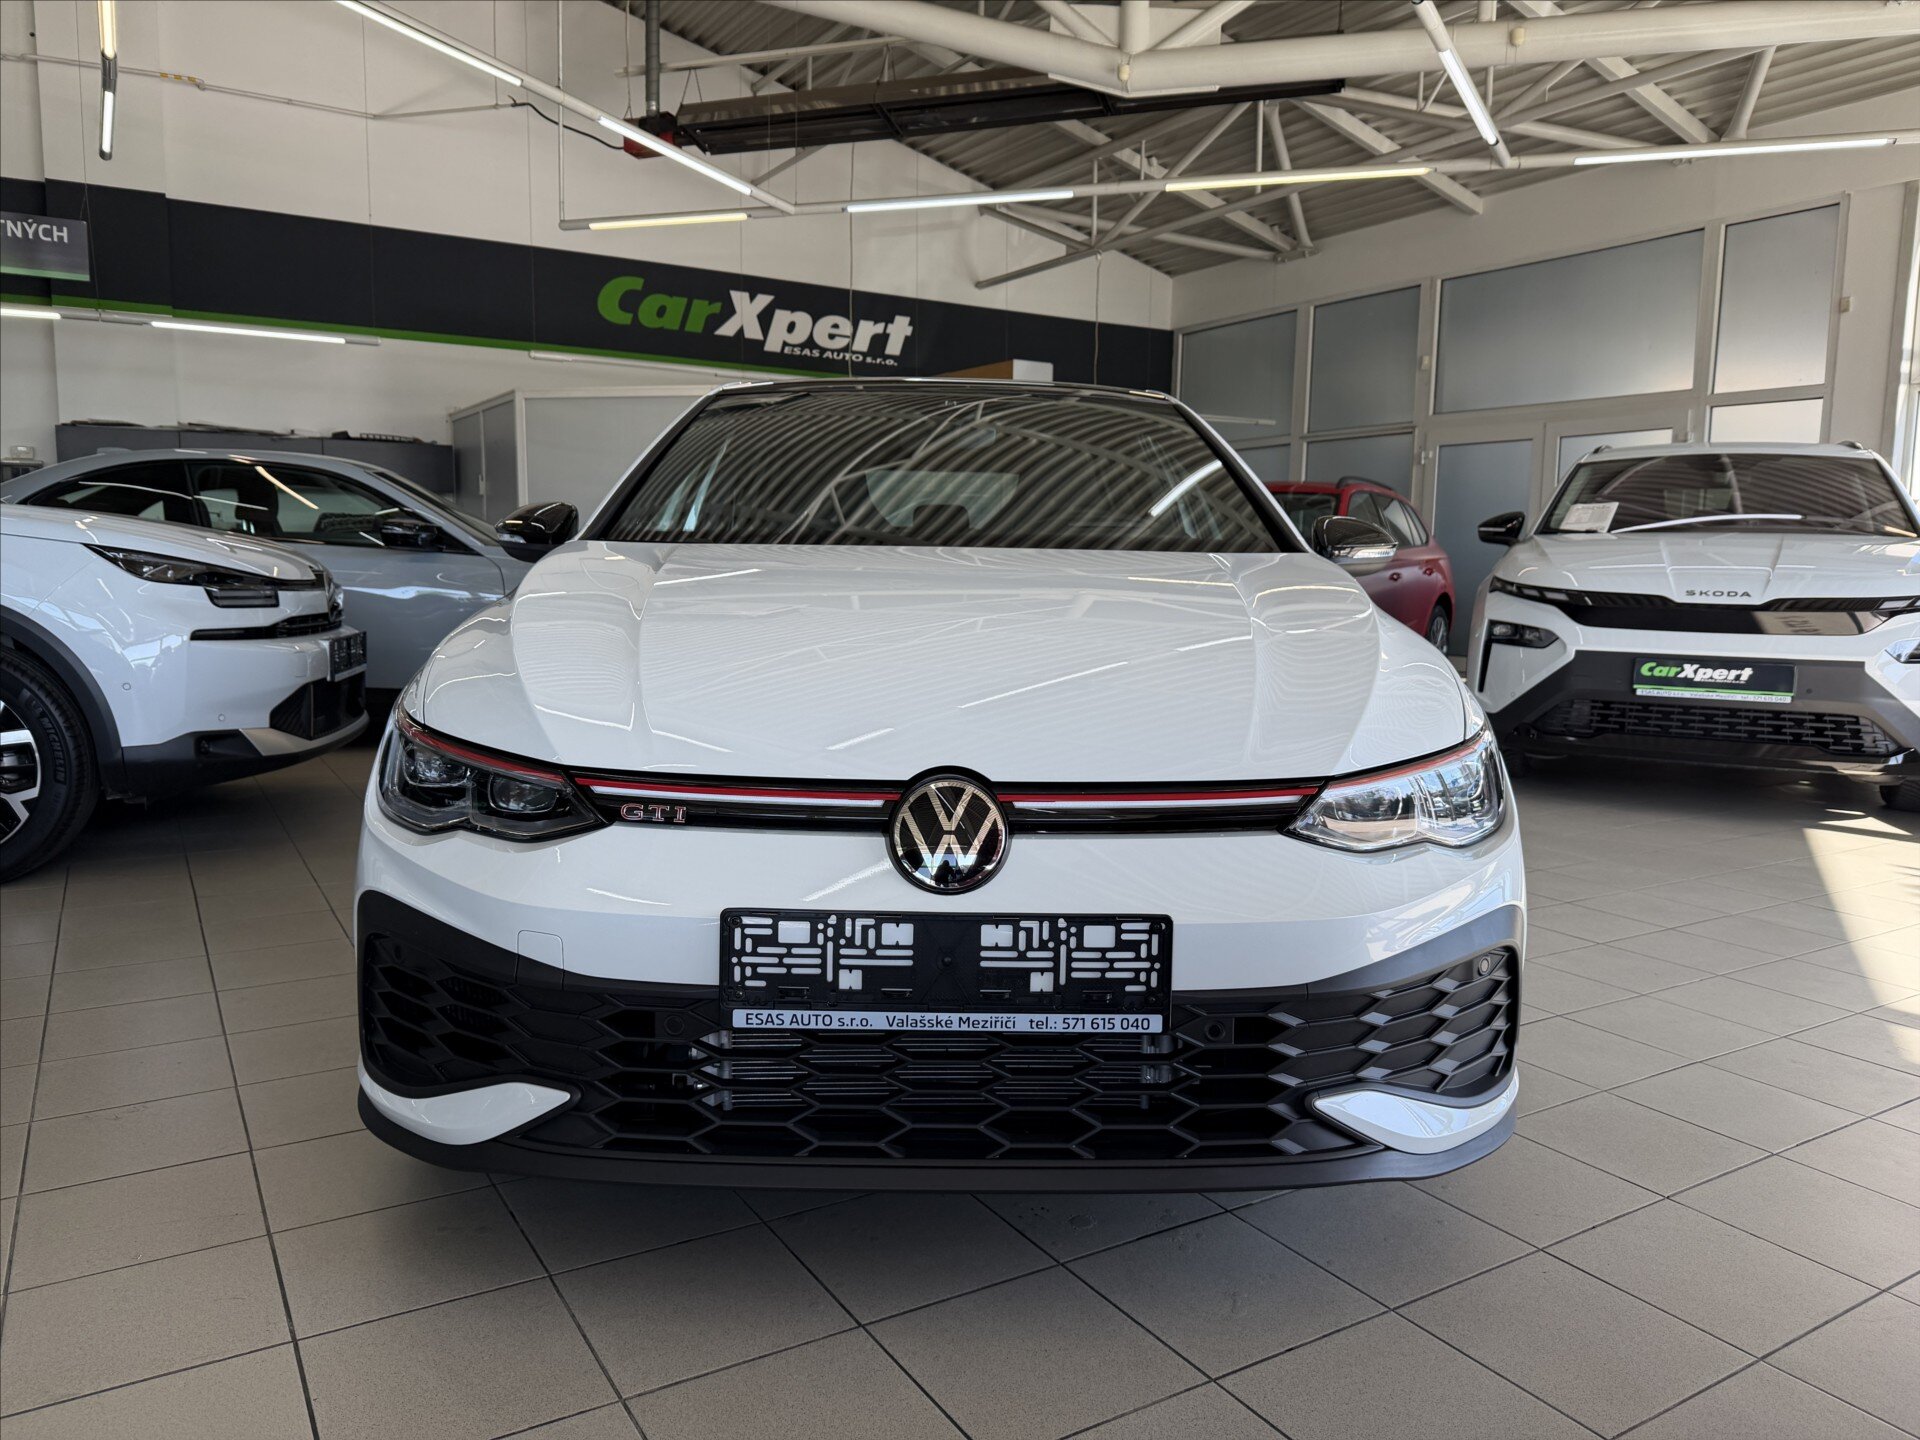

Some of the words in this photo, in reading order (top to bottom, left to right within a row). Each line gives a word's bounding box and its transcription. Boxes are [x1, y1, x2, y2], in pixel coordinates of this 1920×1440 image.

[597, 275, 914, 356] CarXpert
[783, 345, 820, 357] ESAS
[822, 351, 863, 362] AUTO
[865, 356, 898, 366] s.r.o.
[1640, 661, 1754, 682] CarXpert
[620, 802, 687, 823] GTI
[745, 1012, 785, 1026] ESAS
[789, 1013, 833, 1027] AUTO
[837, 1016, 873, 1027] s.r.o.
[885, 1014, 953, 1028] Valašské
[958, 1015, 1016, 1030] Meziříčí
[1028, 1016, 1057, 1030] tel.:
[1062, 1017, 1085, 1030] 571
[1090, 1017, 1115, 1030] 615
[1120, 1017, 1150, 1031] 040
